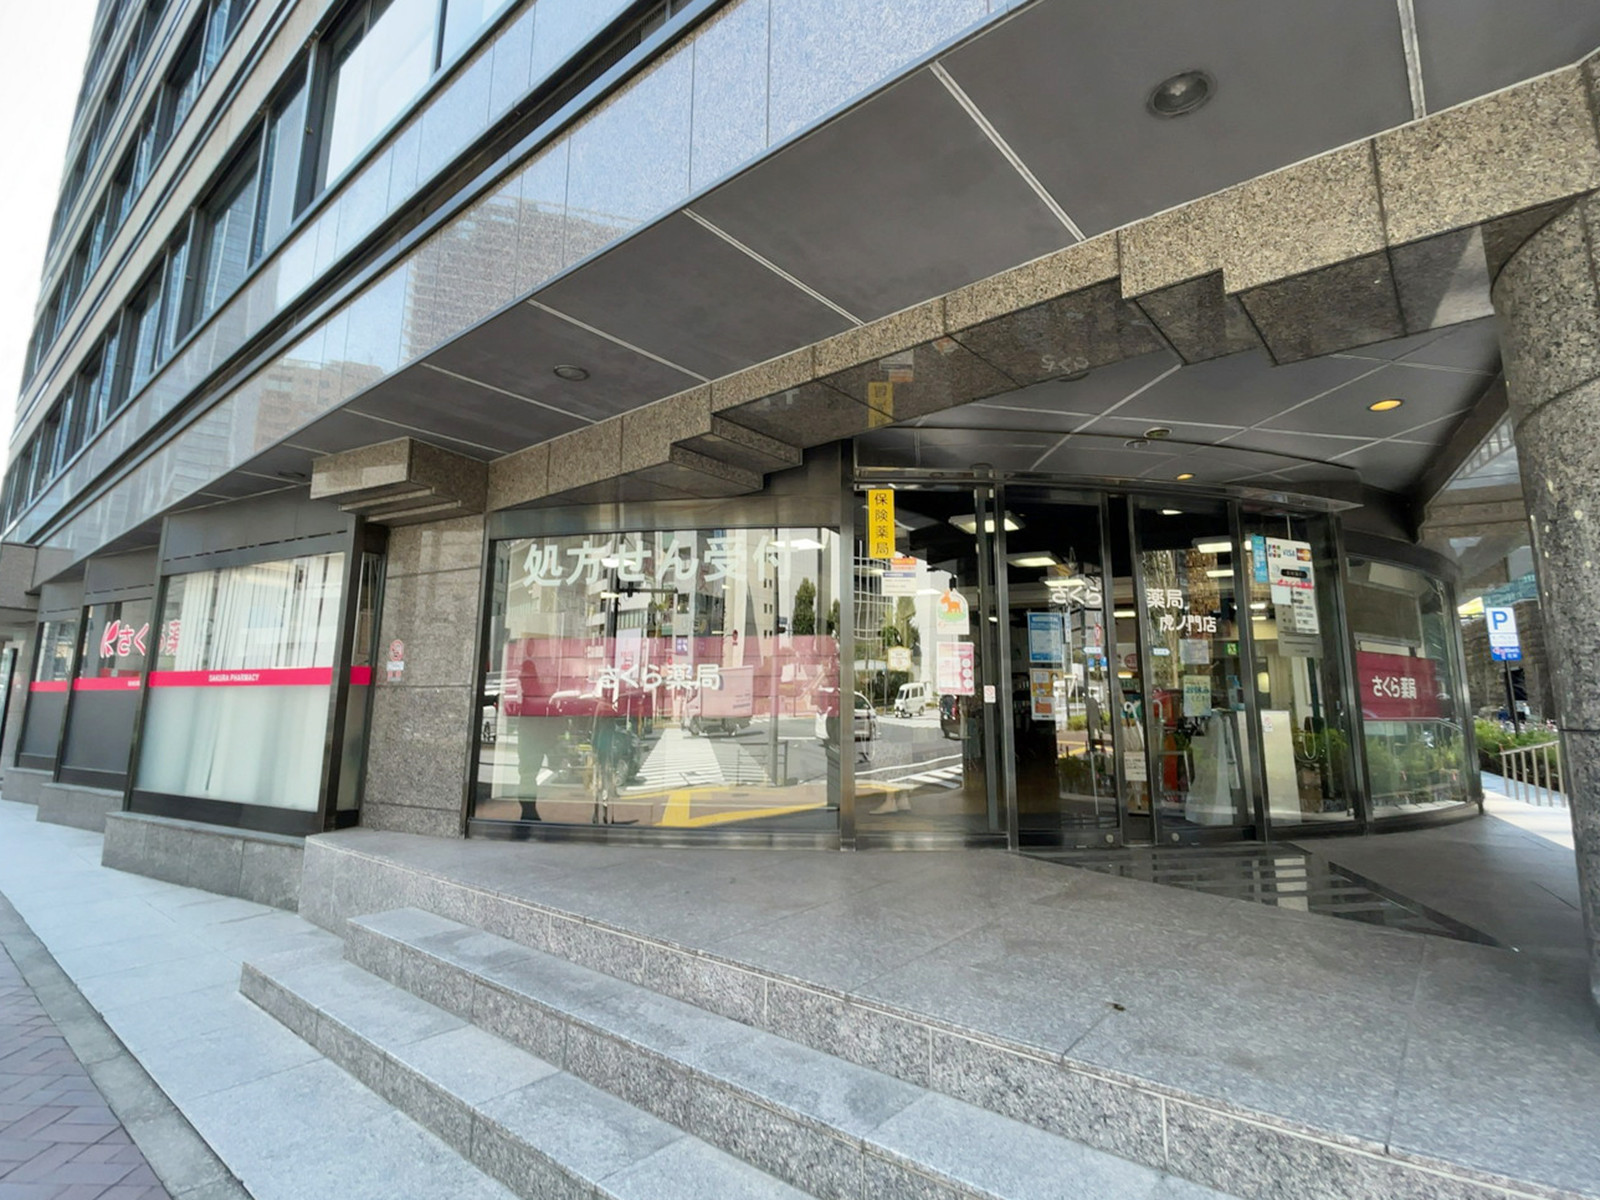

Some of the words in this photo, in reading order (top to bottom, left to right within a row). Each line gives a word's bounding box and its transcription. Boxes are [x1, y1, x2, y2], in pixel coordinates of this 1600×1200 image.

[874, 493, 889, 555] 保険薬局
[523, 536, 791, 587] 処方せん受付
[1145, 588, 1183, 609] 薬局
[1160, 614, 1216, 633] 虎ノ門店
[1491, 611, 1508, 630] P
[598, 663, 721, 692] さくら薬局
